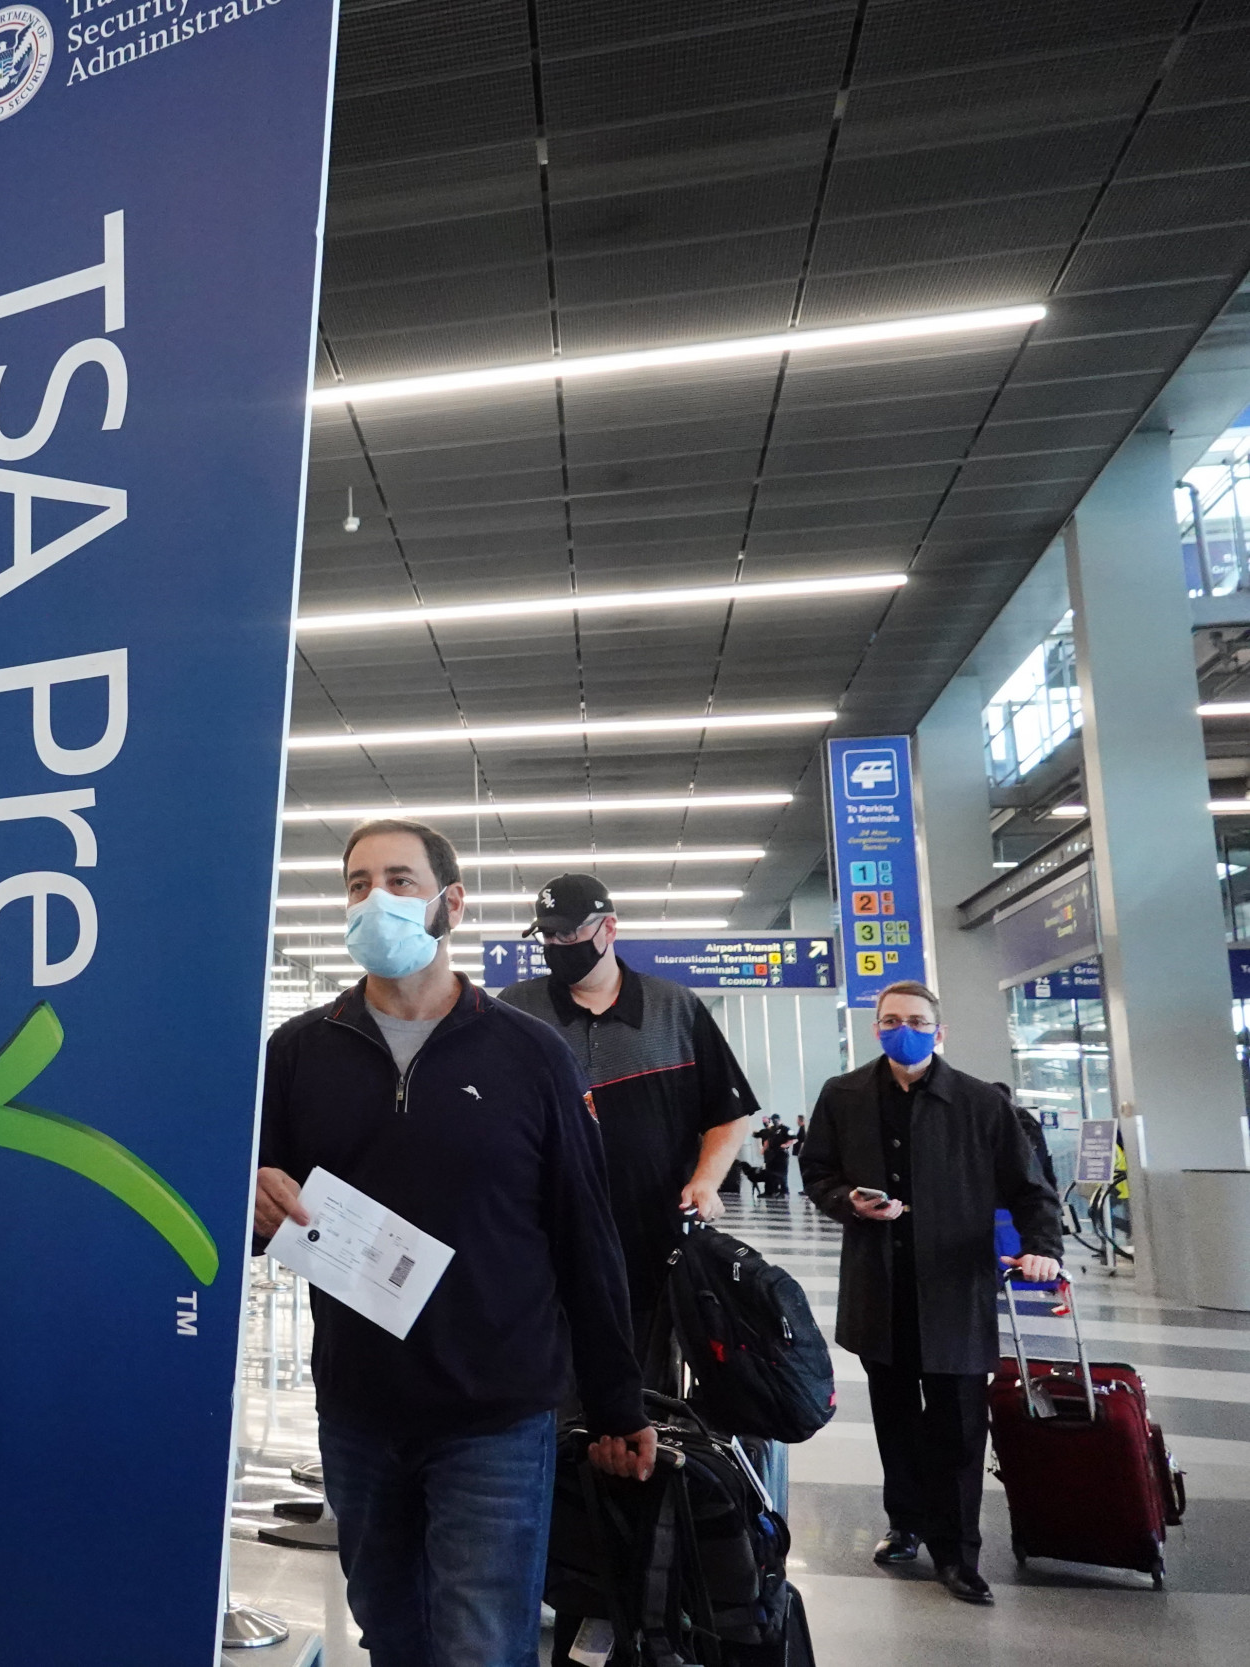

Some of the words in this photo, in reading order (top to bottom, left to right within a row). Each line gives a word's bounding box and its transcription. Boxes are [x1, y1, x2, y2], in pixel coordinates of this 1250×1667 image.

[37, 25, 48, 40] OF
[9, 53, 48, 110] SECURITY
[859, 804, 894, 814] Parking
[859, 895, 872, 911] 2
[861, 925, 874, 941] 3
[705, 943, 742, 953] Airport
[744, 943, 781, 952] Transit
[654, 954, 720, 964] International
[722, 954, 767, 964] Terminal
[864, 955, 876, 971] 5
[689, 965, 740, 974] Terminals
[719, 977, 768, 986] Economy
[176, 1290, 198, 1336] TM
